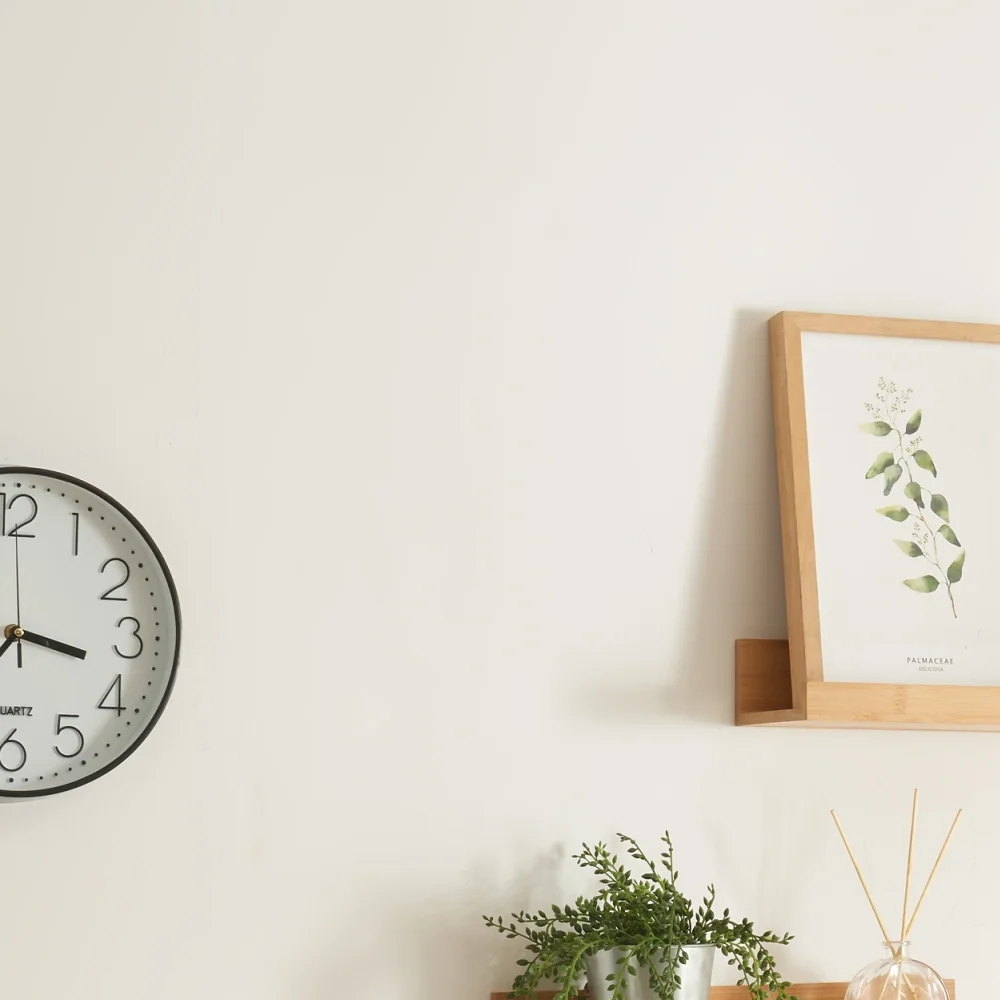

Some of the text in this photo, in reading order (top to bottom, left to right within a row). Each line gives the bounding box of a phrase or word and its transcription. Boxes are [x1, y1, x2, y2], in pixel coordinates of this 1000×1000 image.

[0, 492, 38, 538] 12
[71, 512, 80, 556] 1
[99, 557, 131, 602] 2
[113, 616, 144, 659] 3
[906, 656, 954, 665] PALMACEAE
[0, 705, 33, 717] UARTZ
[97, 673, 127, 717] 4
[0, 727, 27, 773] 6
[54, 714, 85, 759] 5
